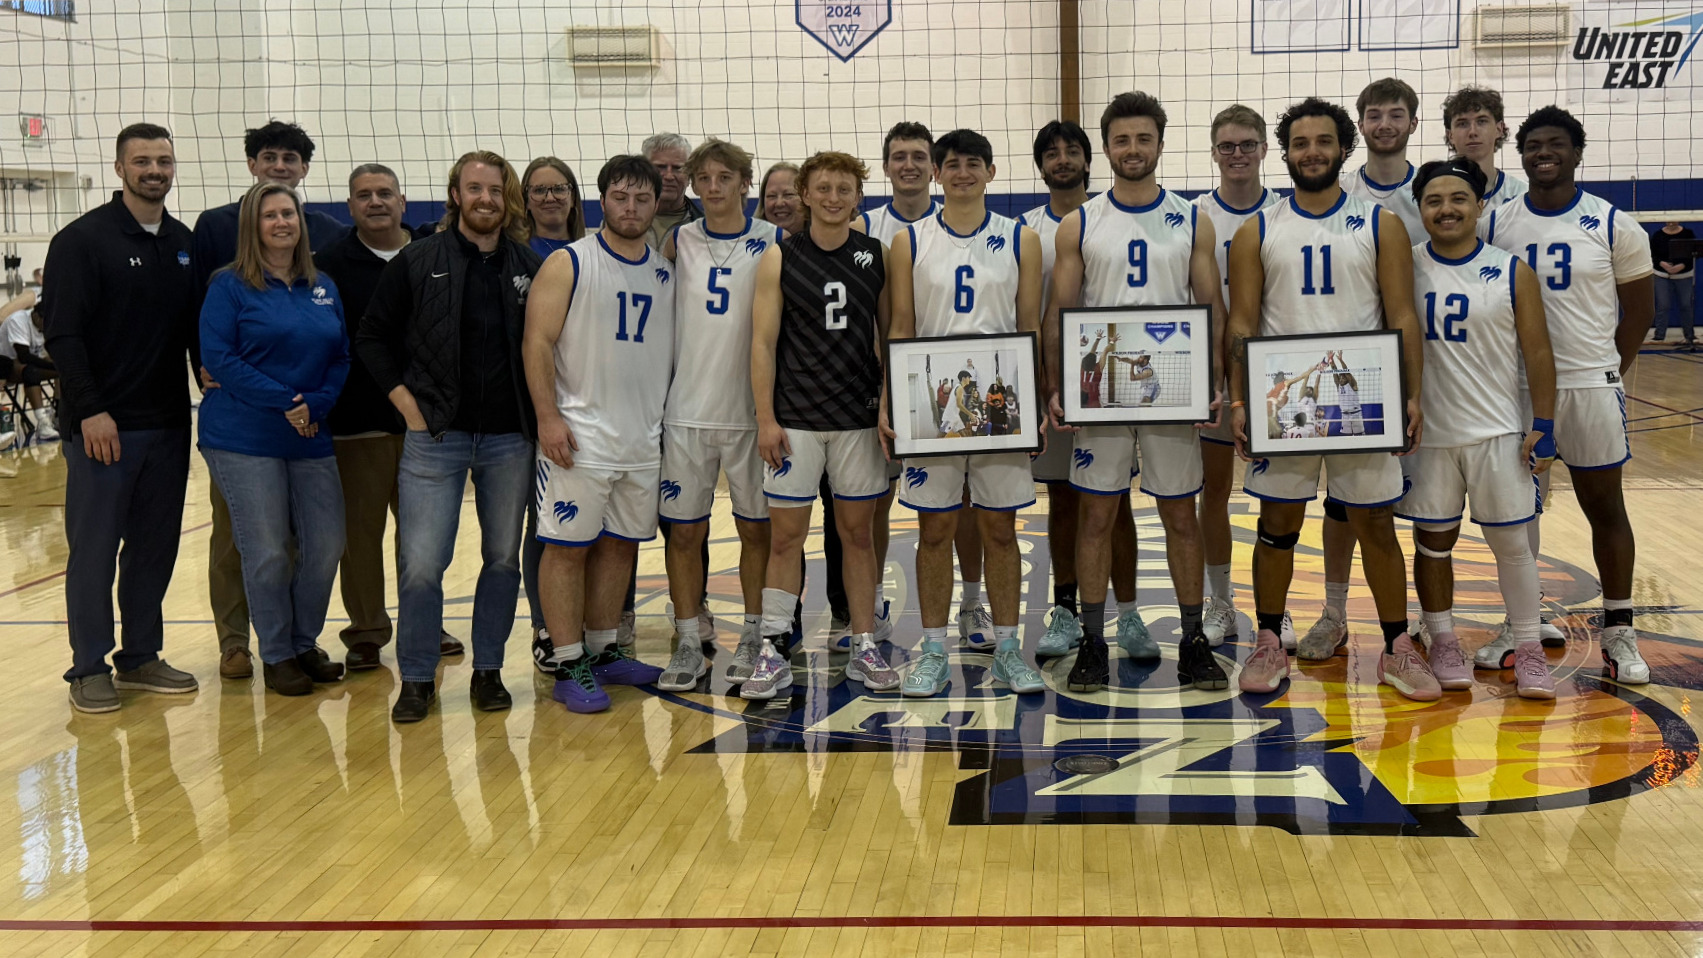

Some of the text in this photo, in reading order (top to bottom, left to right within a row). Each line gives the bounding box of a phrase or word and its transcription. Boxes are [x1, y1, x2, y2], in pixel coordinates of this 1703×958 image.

[826, 5, 862, 18] 2024
[828, 24, 860, 47] W
[1572, 27, 1683, 60] UNITED
[1602, 61, 1675, 89] EAST
[1127, 239, 1148, 287] 9
[1300, 244, 1335, 295] 11
[1525, 242, 1572, 290] 13
[706, 266, 732, 315] 5
[824, 281, 847, 330] 2
[954, 264, 974, 313] 6
[616, 291, 653, 343] 17
[1424, 291, 1469, 343] 12
[1083, 371, 1095, 382] 17
